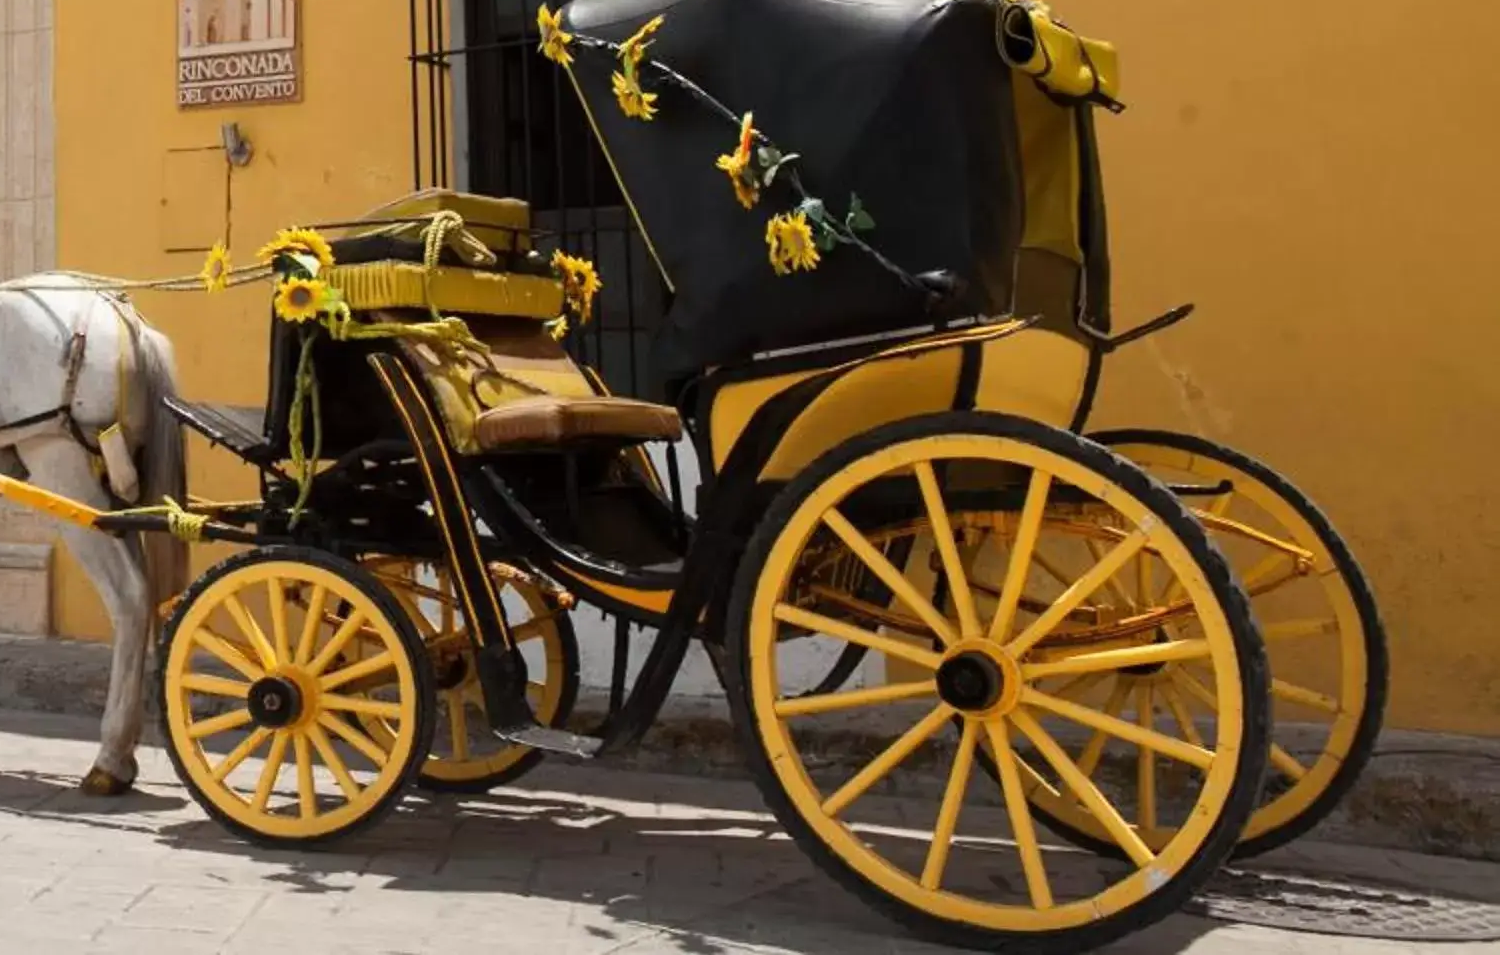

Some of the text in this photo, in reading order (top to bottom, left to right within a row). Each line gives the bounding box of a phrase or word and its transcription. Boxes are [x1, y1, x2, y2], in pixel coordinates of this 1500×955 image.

[179, 53, 293, 81] RINCONADA
[179, 80, 295, 104] DEL CONVENTO
